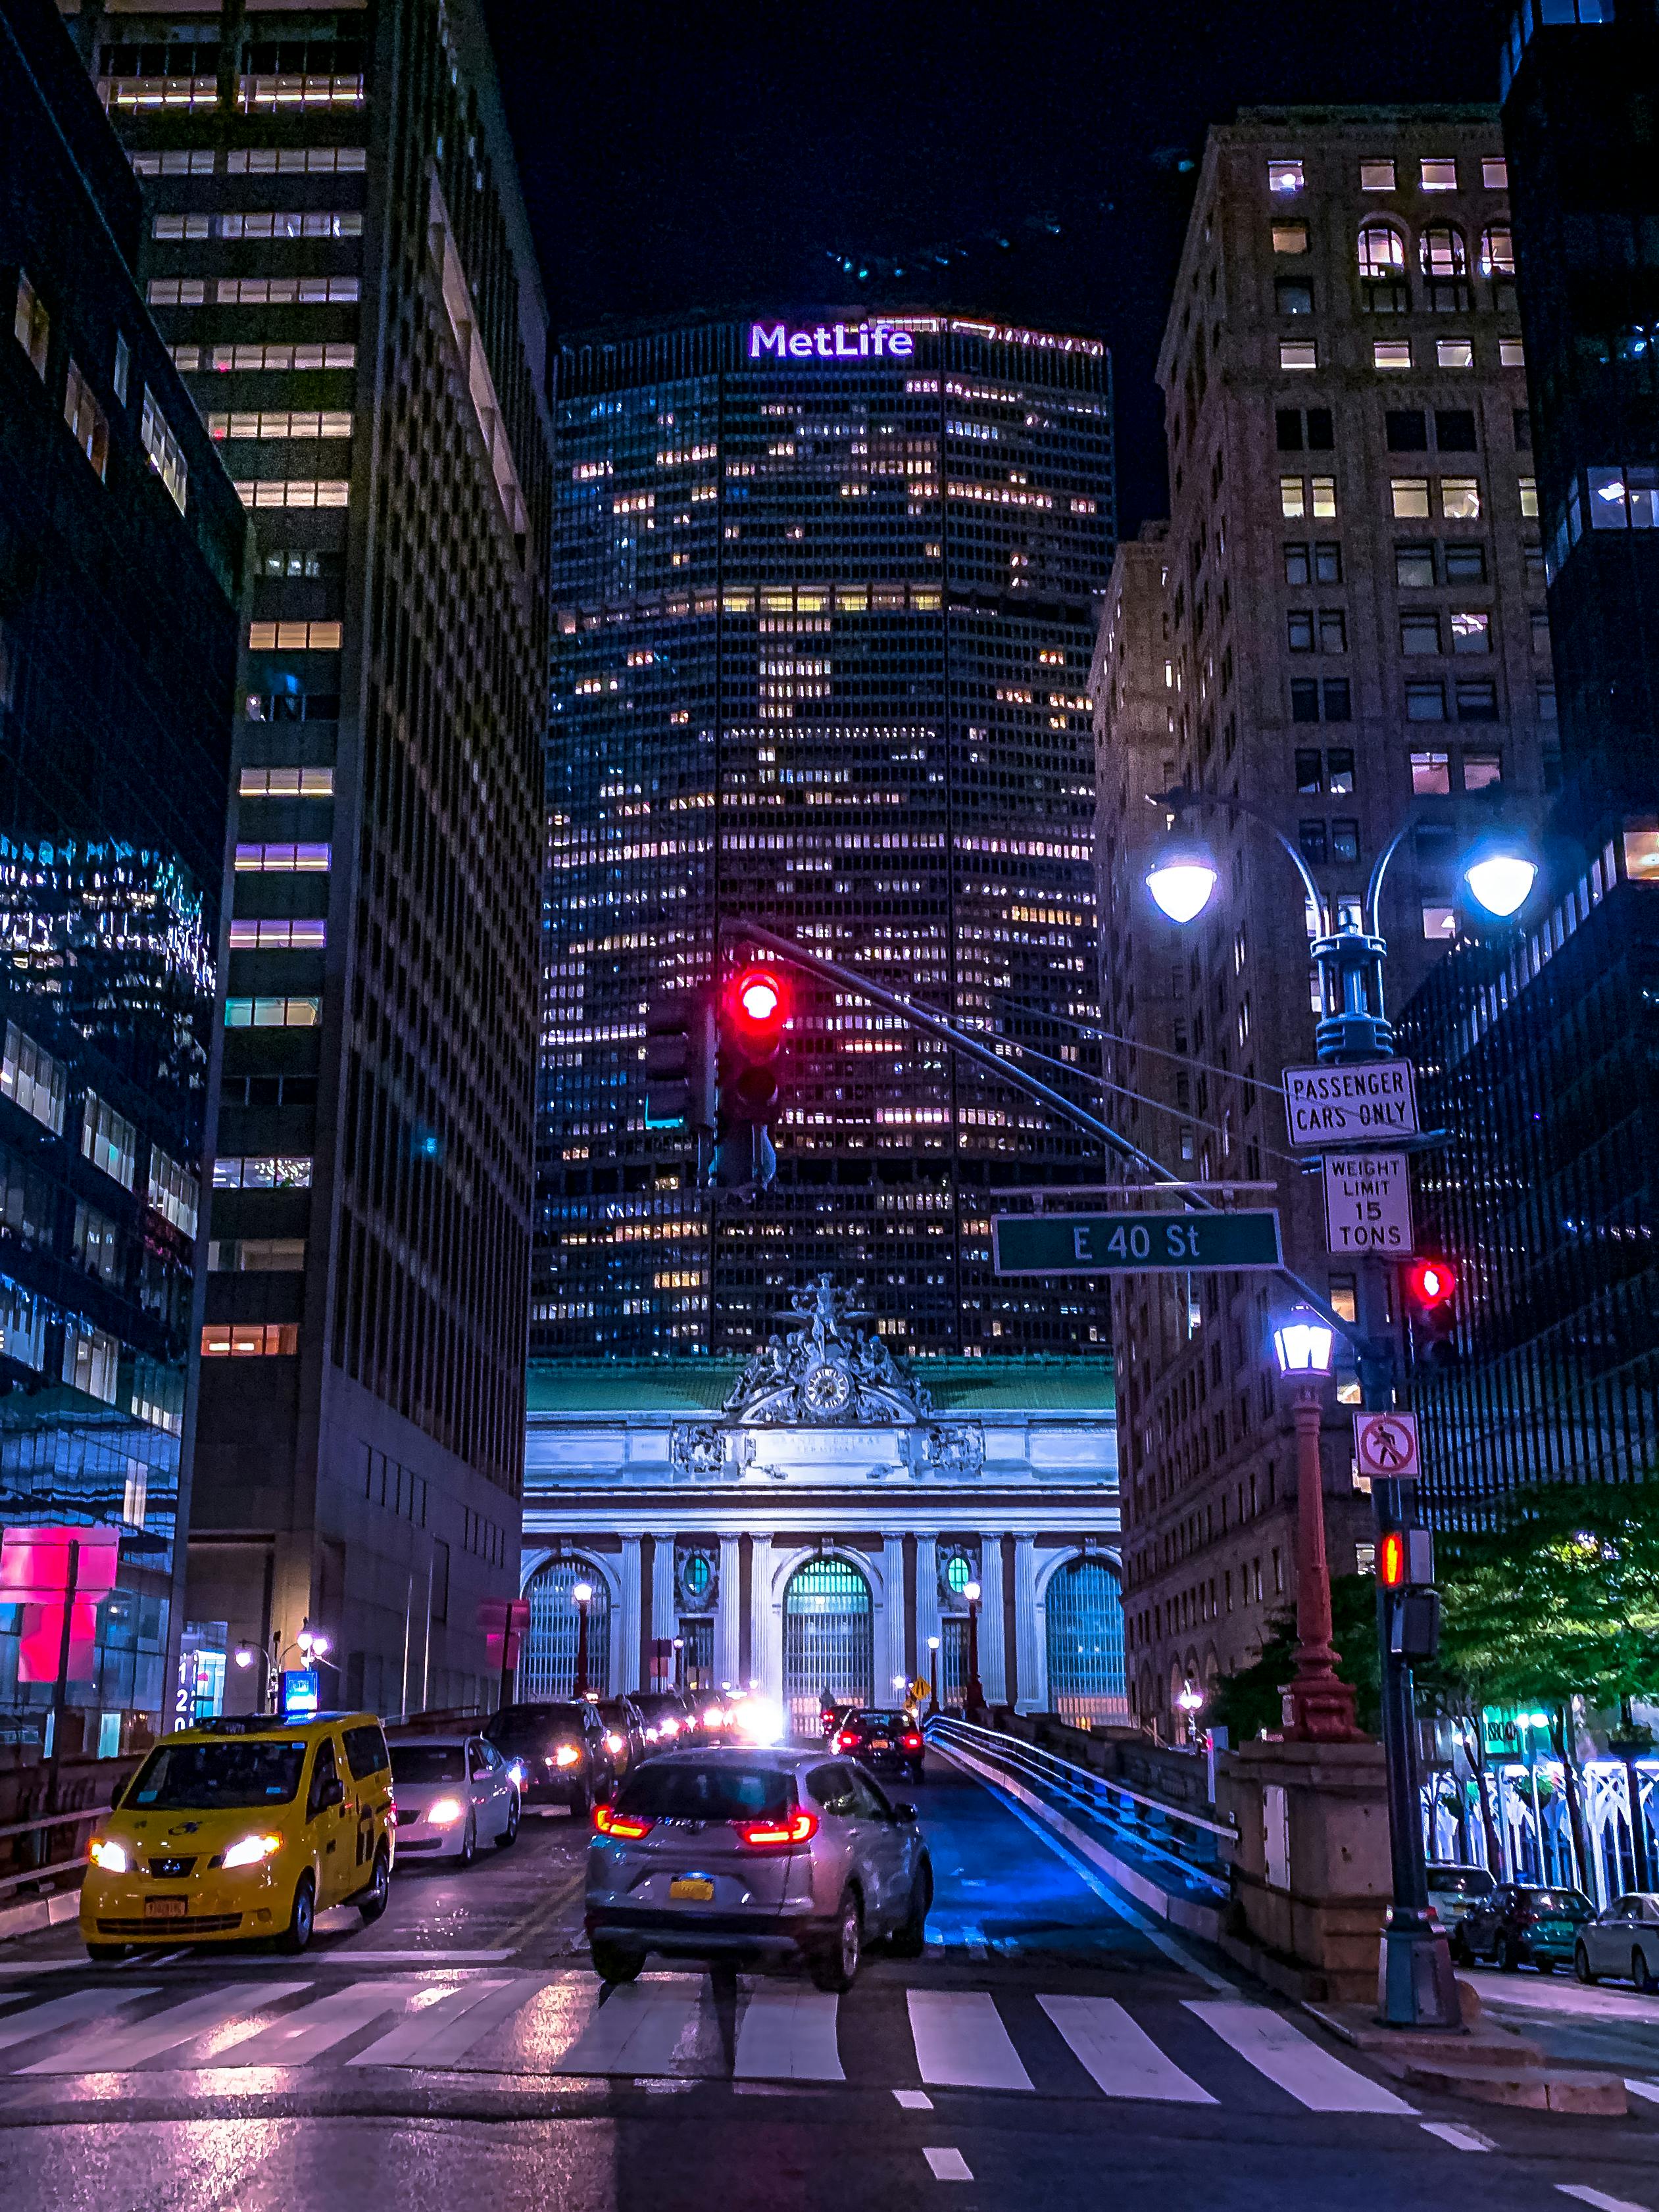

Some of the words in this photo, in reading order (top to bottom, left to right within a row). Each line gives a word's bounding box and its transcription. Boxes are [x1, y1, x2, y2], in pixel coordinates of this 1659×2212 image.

[750, 323, 913, 357] MetLife
[1293, 1071, 1404, 1100] PASSENGER
[1297, 1107, 1347, 1131] CARS
[1359, 1101, 1406, 1126] ONLY
[1332, 1160, 1400, 1177] WEIGHT
[1343, 1180, 1390, 1196] LIMIT
[1355, 1201, 1381, 1221] 15
[1074, 1226, 1093, 1260] E
[1108, 1224, 1151, 1259] 40
[1166, 1224, 1200, 1258] St
[1339, 1225, 1400, 1246] TONS
